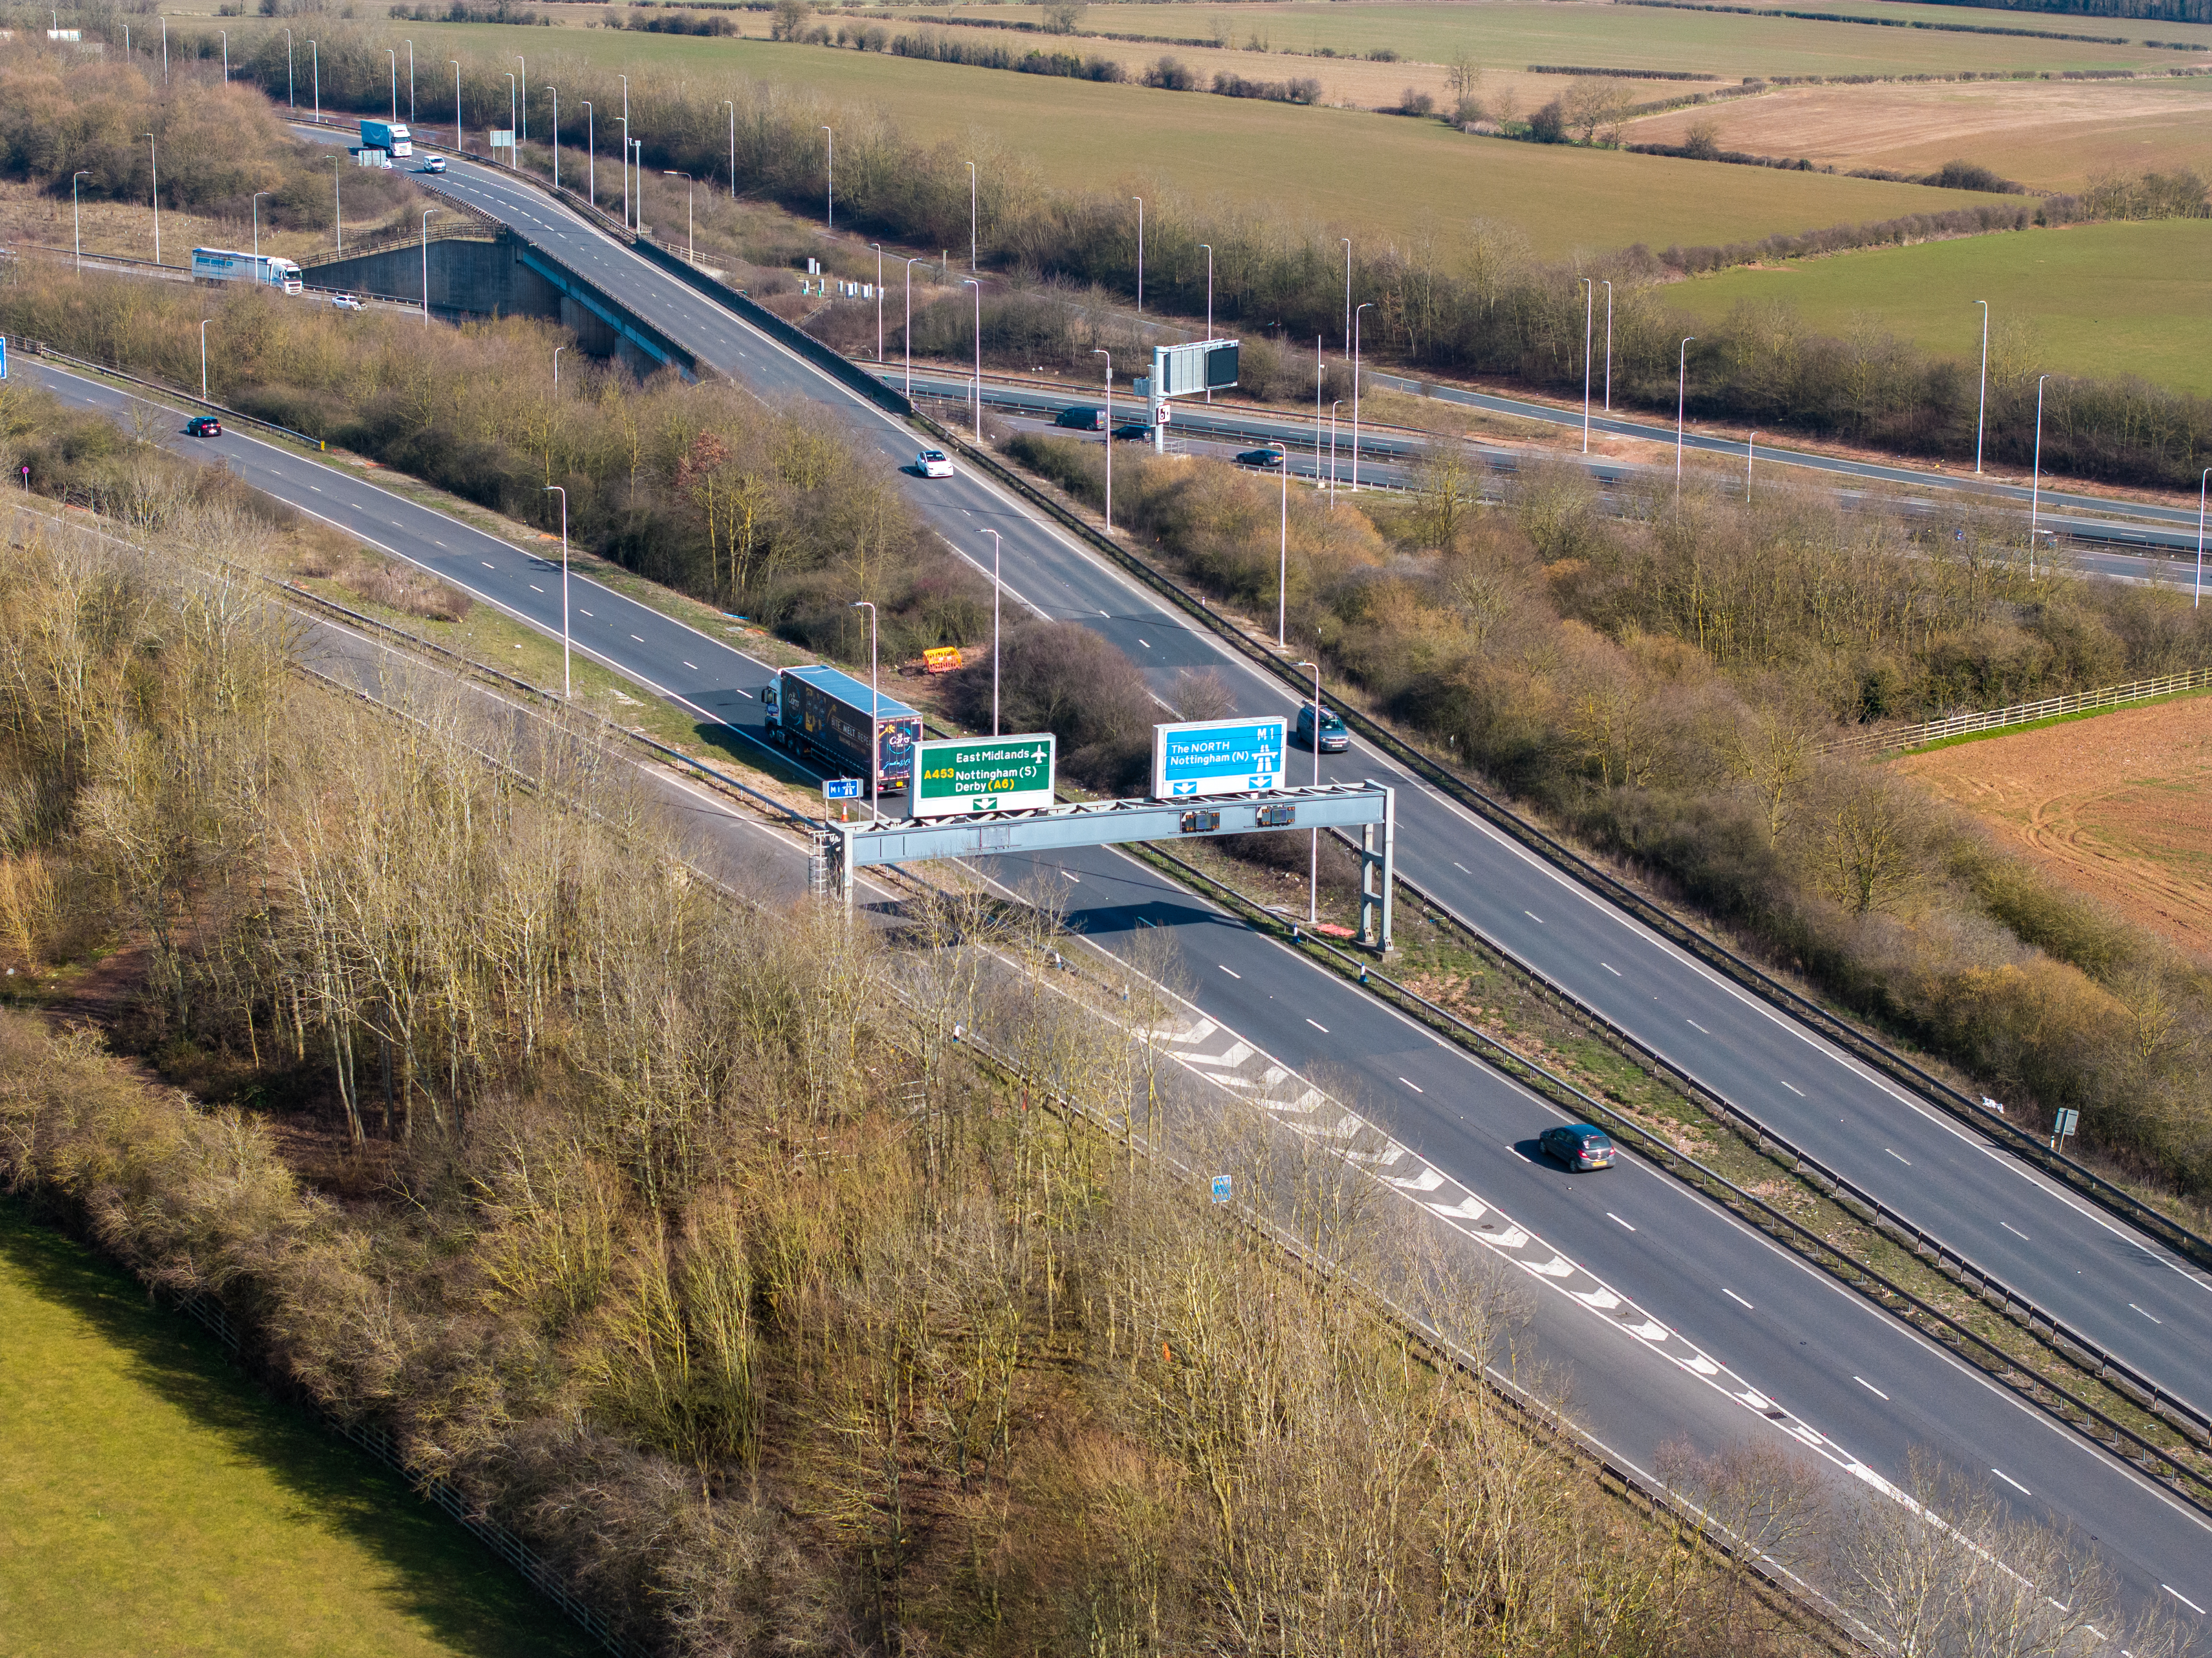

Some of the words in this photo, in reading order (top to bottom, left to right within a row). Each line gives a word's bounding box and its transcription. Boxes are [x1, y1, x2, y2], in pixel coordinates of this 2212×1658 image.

[1171, 744, 1190, 754] The
[1191, 741, 1230, 753] NORTH
[956, 752, 980, 763] East
[982, 749, 1030, 761] Midlands
[1170, 754, 1230, 766] Nottingham
[1232, 750, 1249, 762] (N)
[924, 768, 954, 780] A453
[955, 768, 1017, 781] Nottingham
[1019, 766, 1037, 778] (S)
[955, 782, 986, 793] Derby
[988, 778, 1015, 792] (A6)
